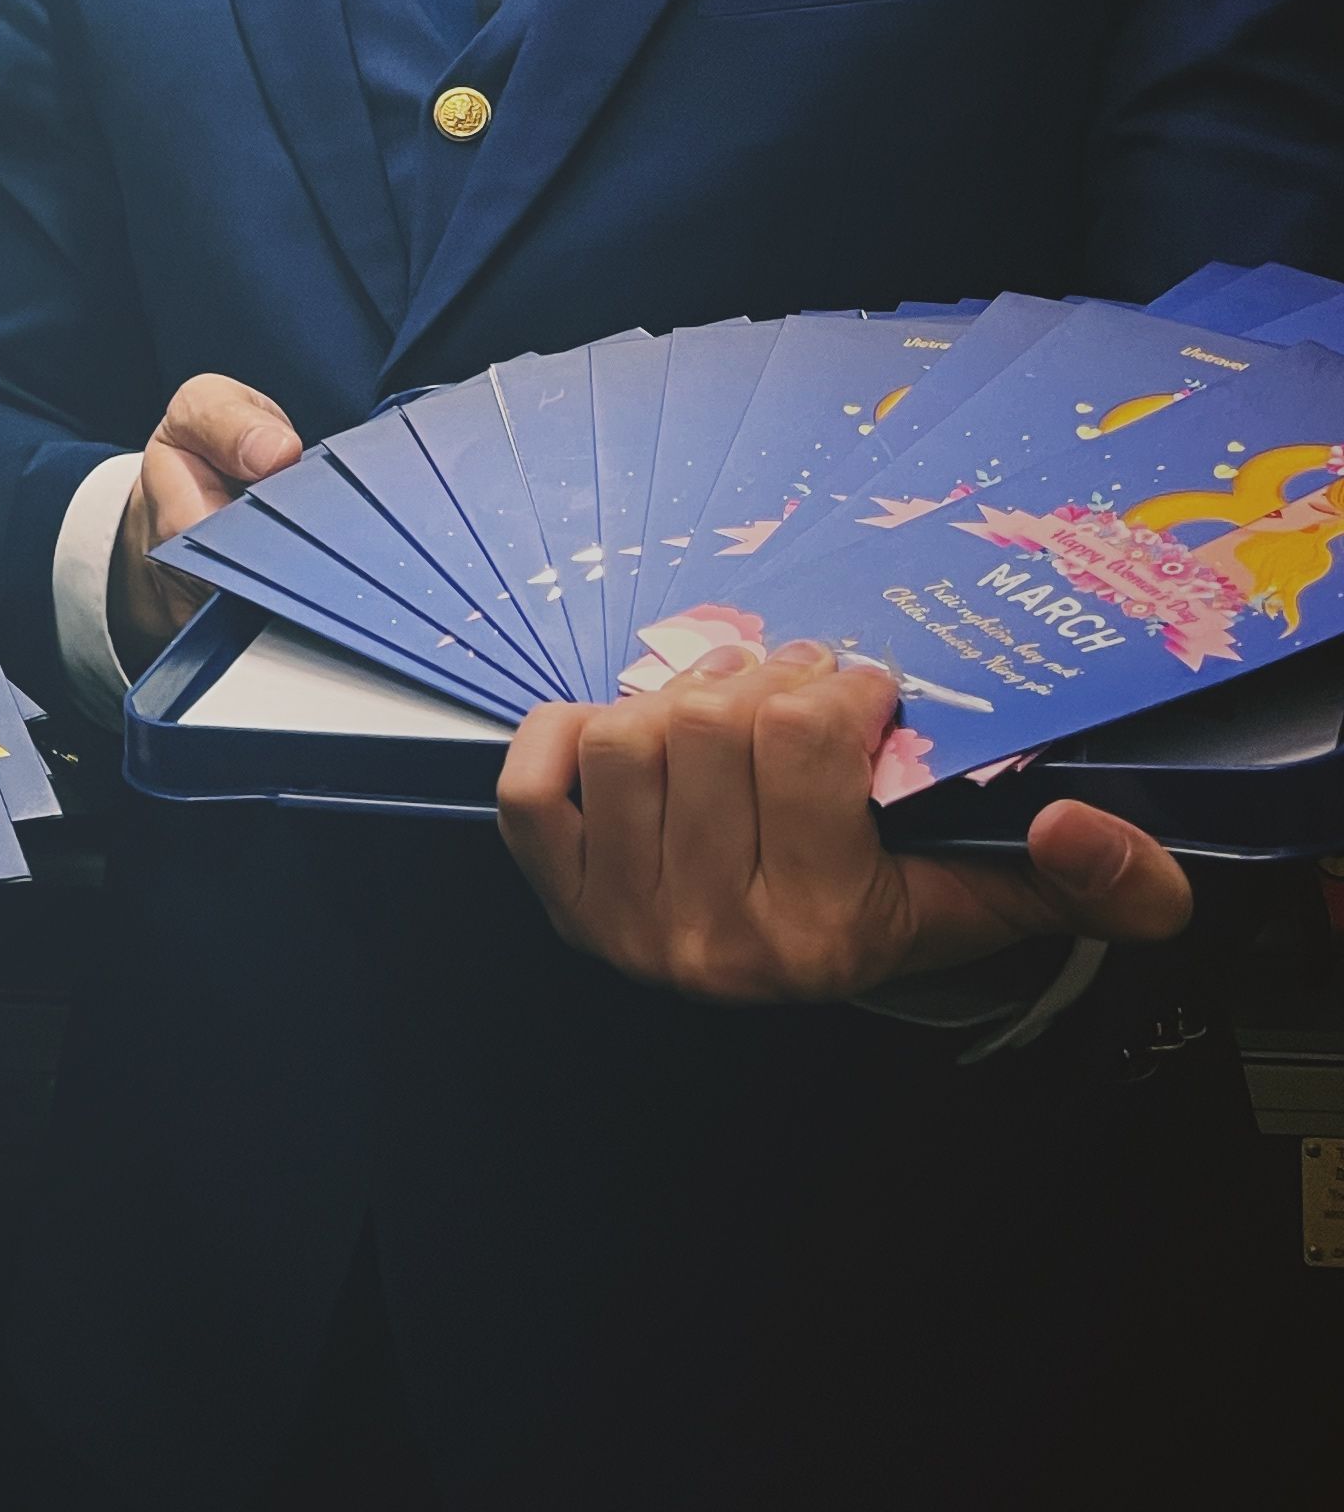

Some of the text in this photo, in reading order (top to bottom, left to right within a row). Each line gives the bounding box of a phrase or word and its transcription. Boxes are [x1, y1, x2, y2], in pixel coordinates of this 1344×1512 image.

[976, 562, 1127, 653] MARCH
[1050, 528, 1106, 565] Happy
[1166, 599, 1201, 626] Day
